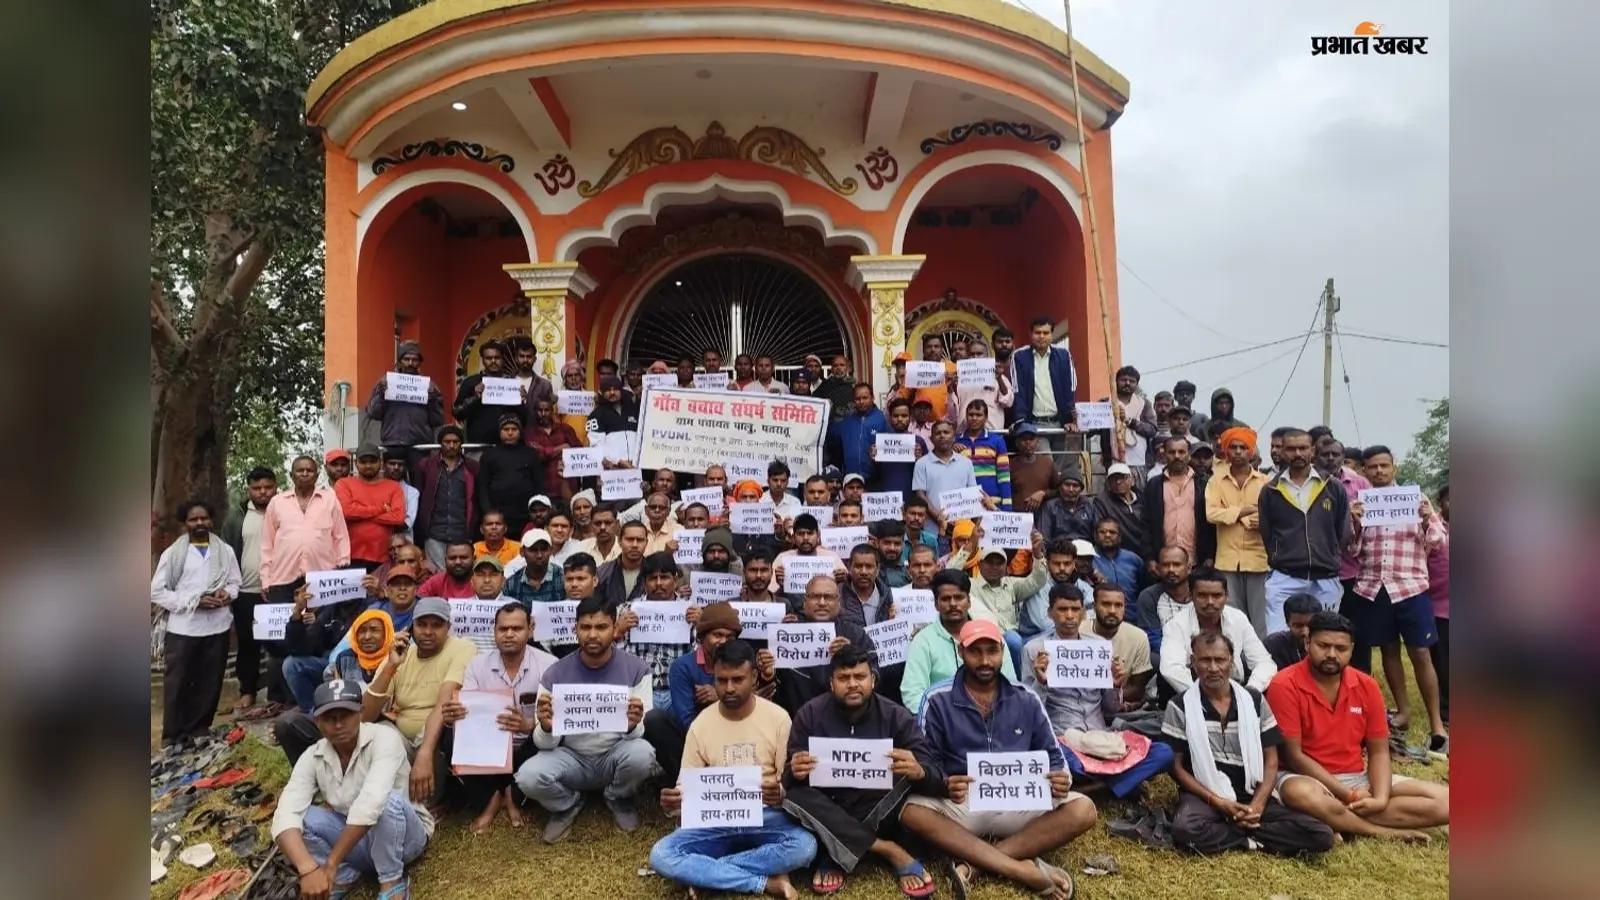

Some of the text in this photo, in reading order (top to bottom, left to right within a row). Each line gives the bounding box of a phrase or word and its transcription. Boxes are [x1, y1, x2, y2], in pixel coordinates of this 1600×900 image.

[772, 403, 818, 424] समिति
[698, 418, 730, 429] पंचायत
[652, 429, 691, 441] PVUNL
[570, 453, 588, 461] NTPC
[1363, 492, 1419, 504] रेल सरकार
[1365, 507, 1414, 520] हाय-हाय।
[992, 538, 1028, 546] हाय-हाय।
[319, 577, 347, 588] NTPC
[741, 607, 768, 617] NTPC
[268, 616, 287, 626] महोद
[742, 621, 767, 631] हाय-ह
[777, 629, 831, 644] बिछाने के
[777, 646, 828, 661] विरोध में।
[1056, 644, 1110, 660] बिछाने के
[1056, 663, 1108, 678] विरोध में।
[564, 690, 627, 702] सांसद महोदय
[564, 705, 617, 715] अपना वादा
[564, 717, 599, 730] निभाएं।
[831, 750, 872, 763] NTPC
[831, 767, 887, 780] हाय-हाय
[978, 758, 1044, 778] बिछाने के
[700, 773, 735, 788] पतरातु
[701, 788, 762, 802] अंचलाधिका
[979, 781, 1043, 799] विरोध में।
[701, 808, 750, 822] हाय-हाय।
